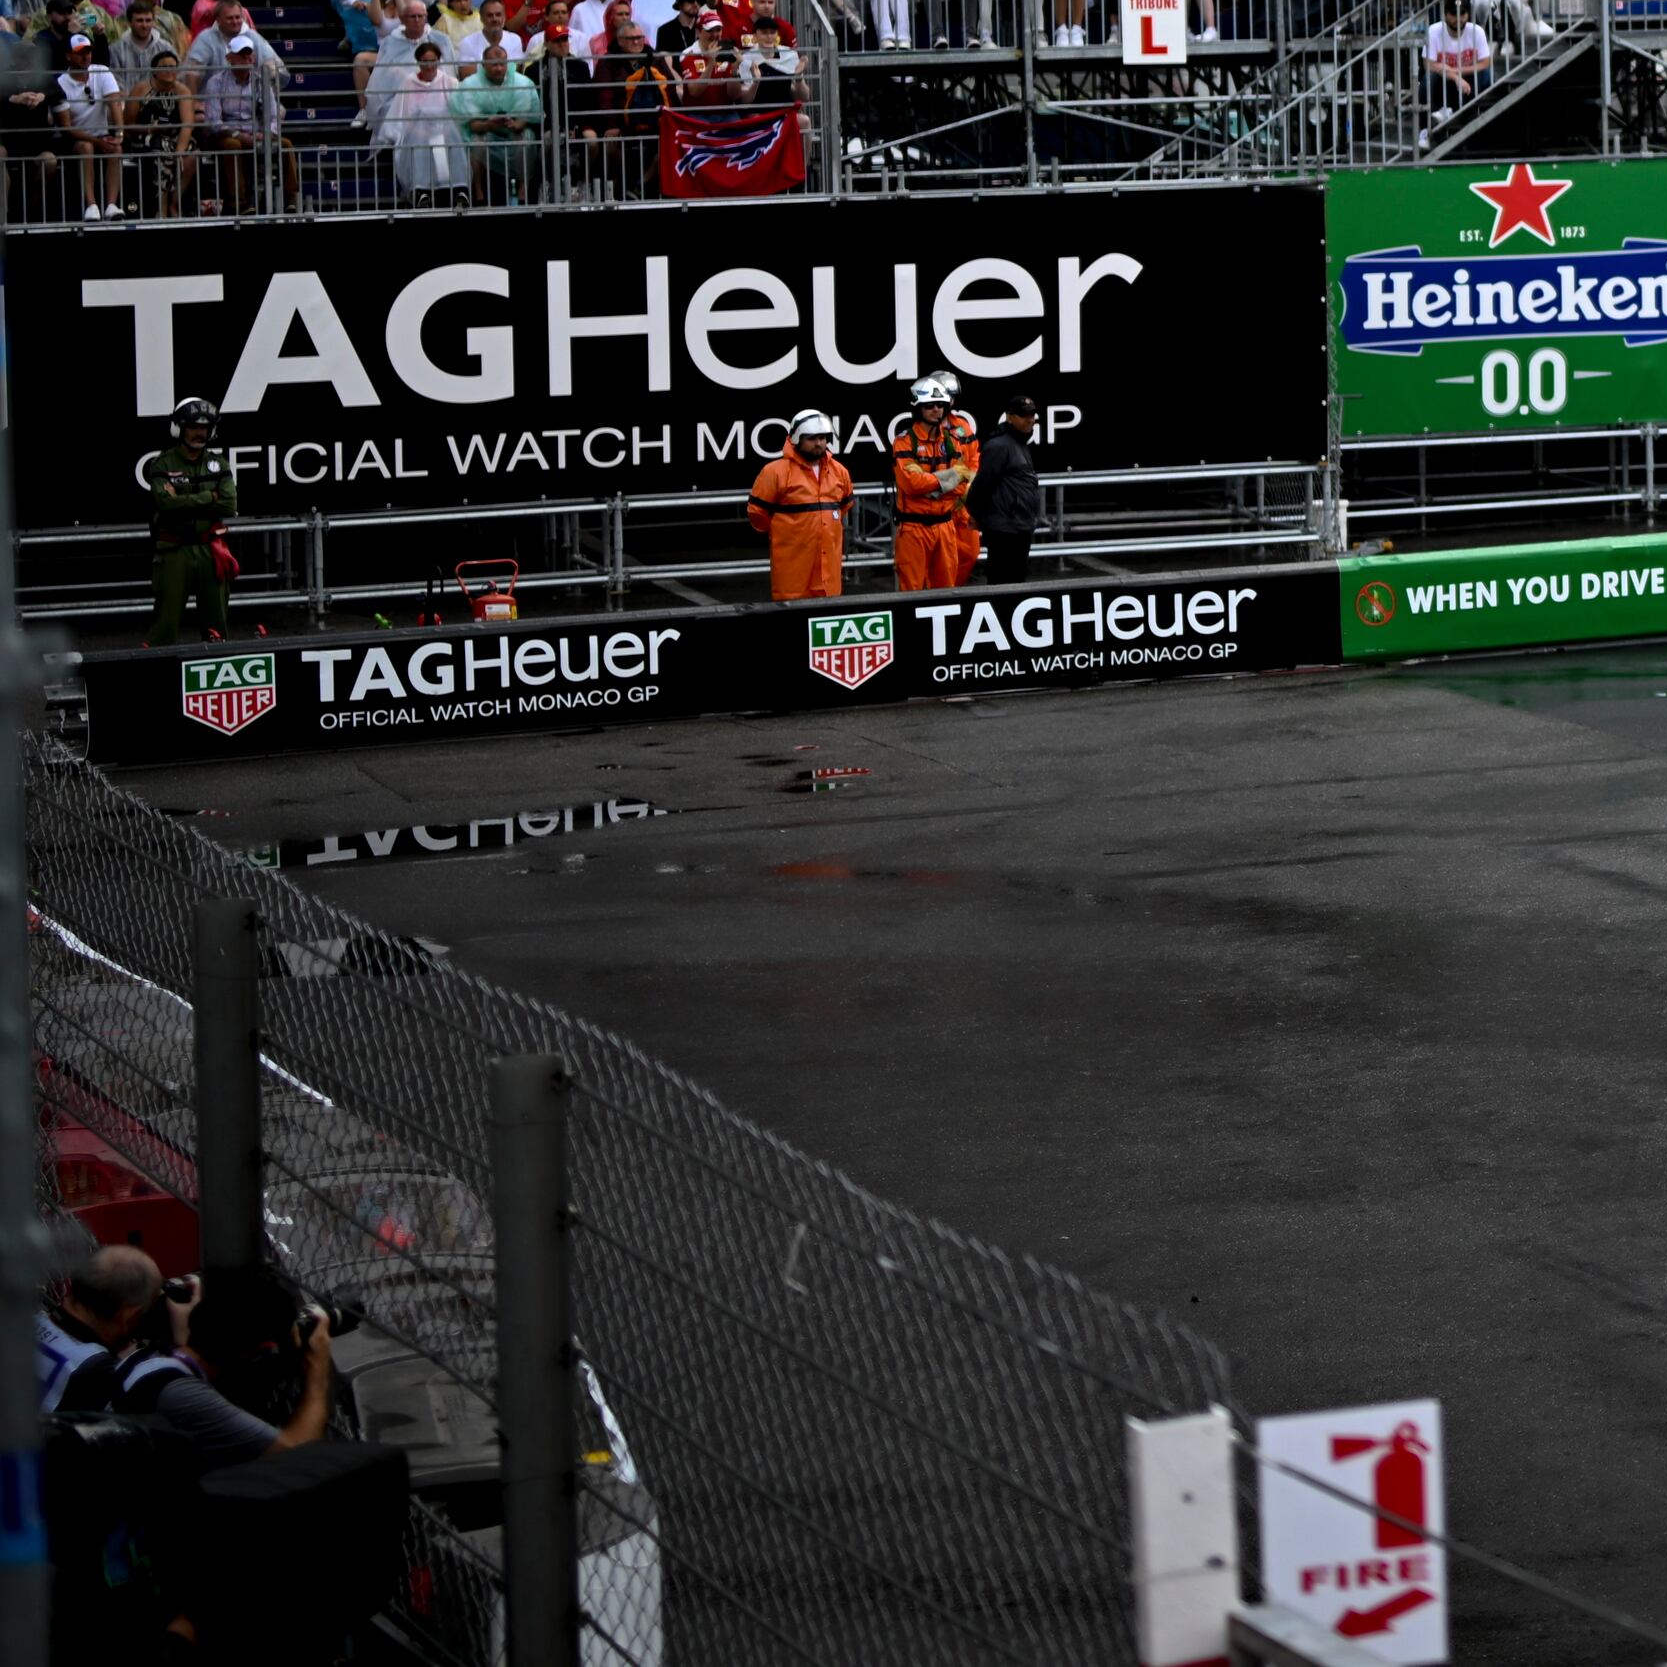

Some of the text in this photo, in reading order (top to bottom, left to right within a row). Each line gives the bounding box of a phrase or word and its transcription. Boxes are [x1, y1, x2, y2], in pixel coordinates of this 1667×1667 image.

[1141, 16, 1168, 54] L
[1459, 230, 1484, 242] EST.
[1560, 226, 1586, 239] 1873
[1481, 348, 1567, 416] 0.0
[447, 424, 671, 475] WATCH
[1406, 581, 1498, 614] WHEN
[1507, 575, 1570, 606] YOU
[1580, 567, 1665, 601] DRIVE
[817, 617, 886, 644] TAG
[191, 659, 267, 687] TAG
[814, 643, 891, 683] HEUER
[933, 642, 1238, 682] OFFICIAL WATCH MONACO GP
[188, 688, 271, 729] HEUER
[320, 686, 660, 729] OFFICIAL WATCH MONACO GP
[1300, 1556, 1430, 1594] FIRE
